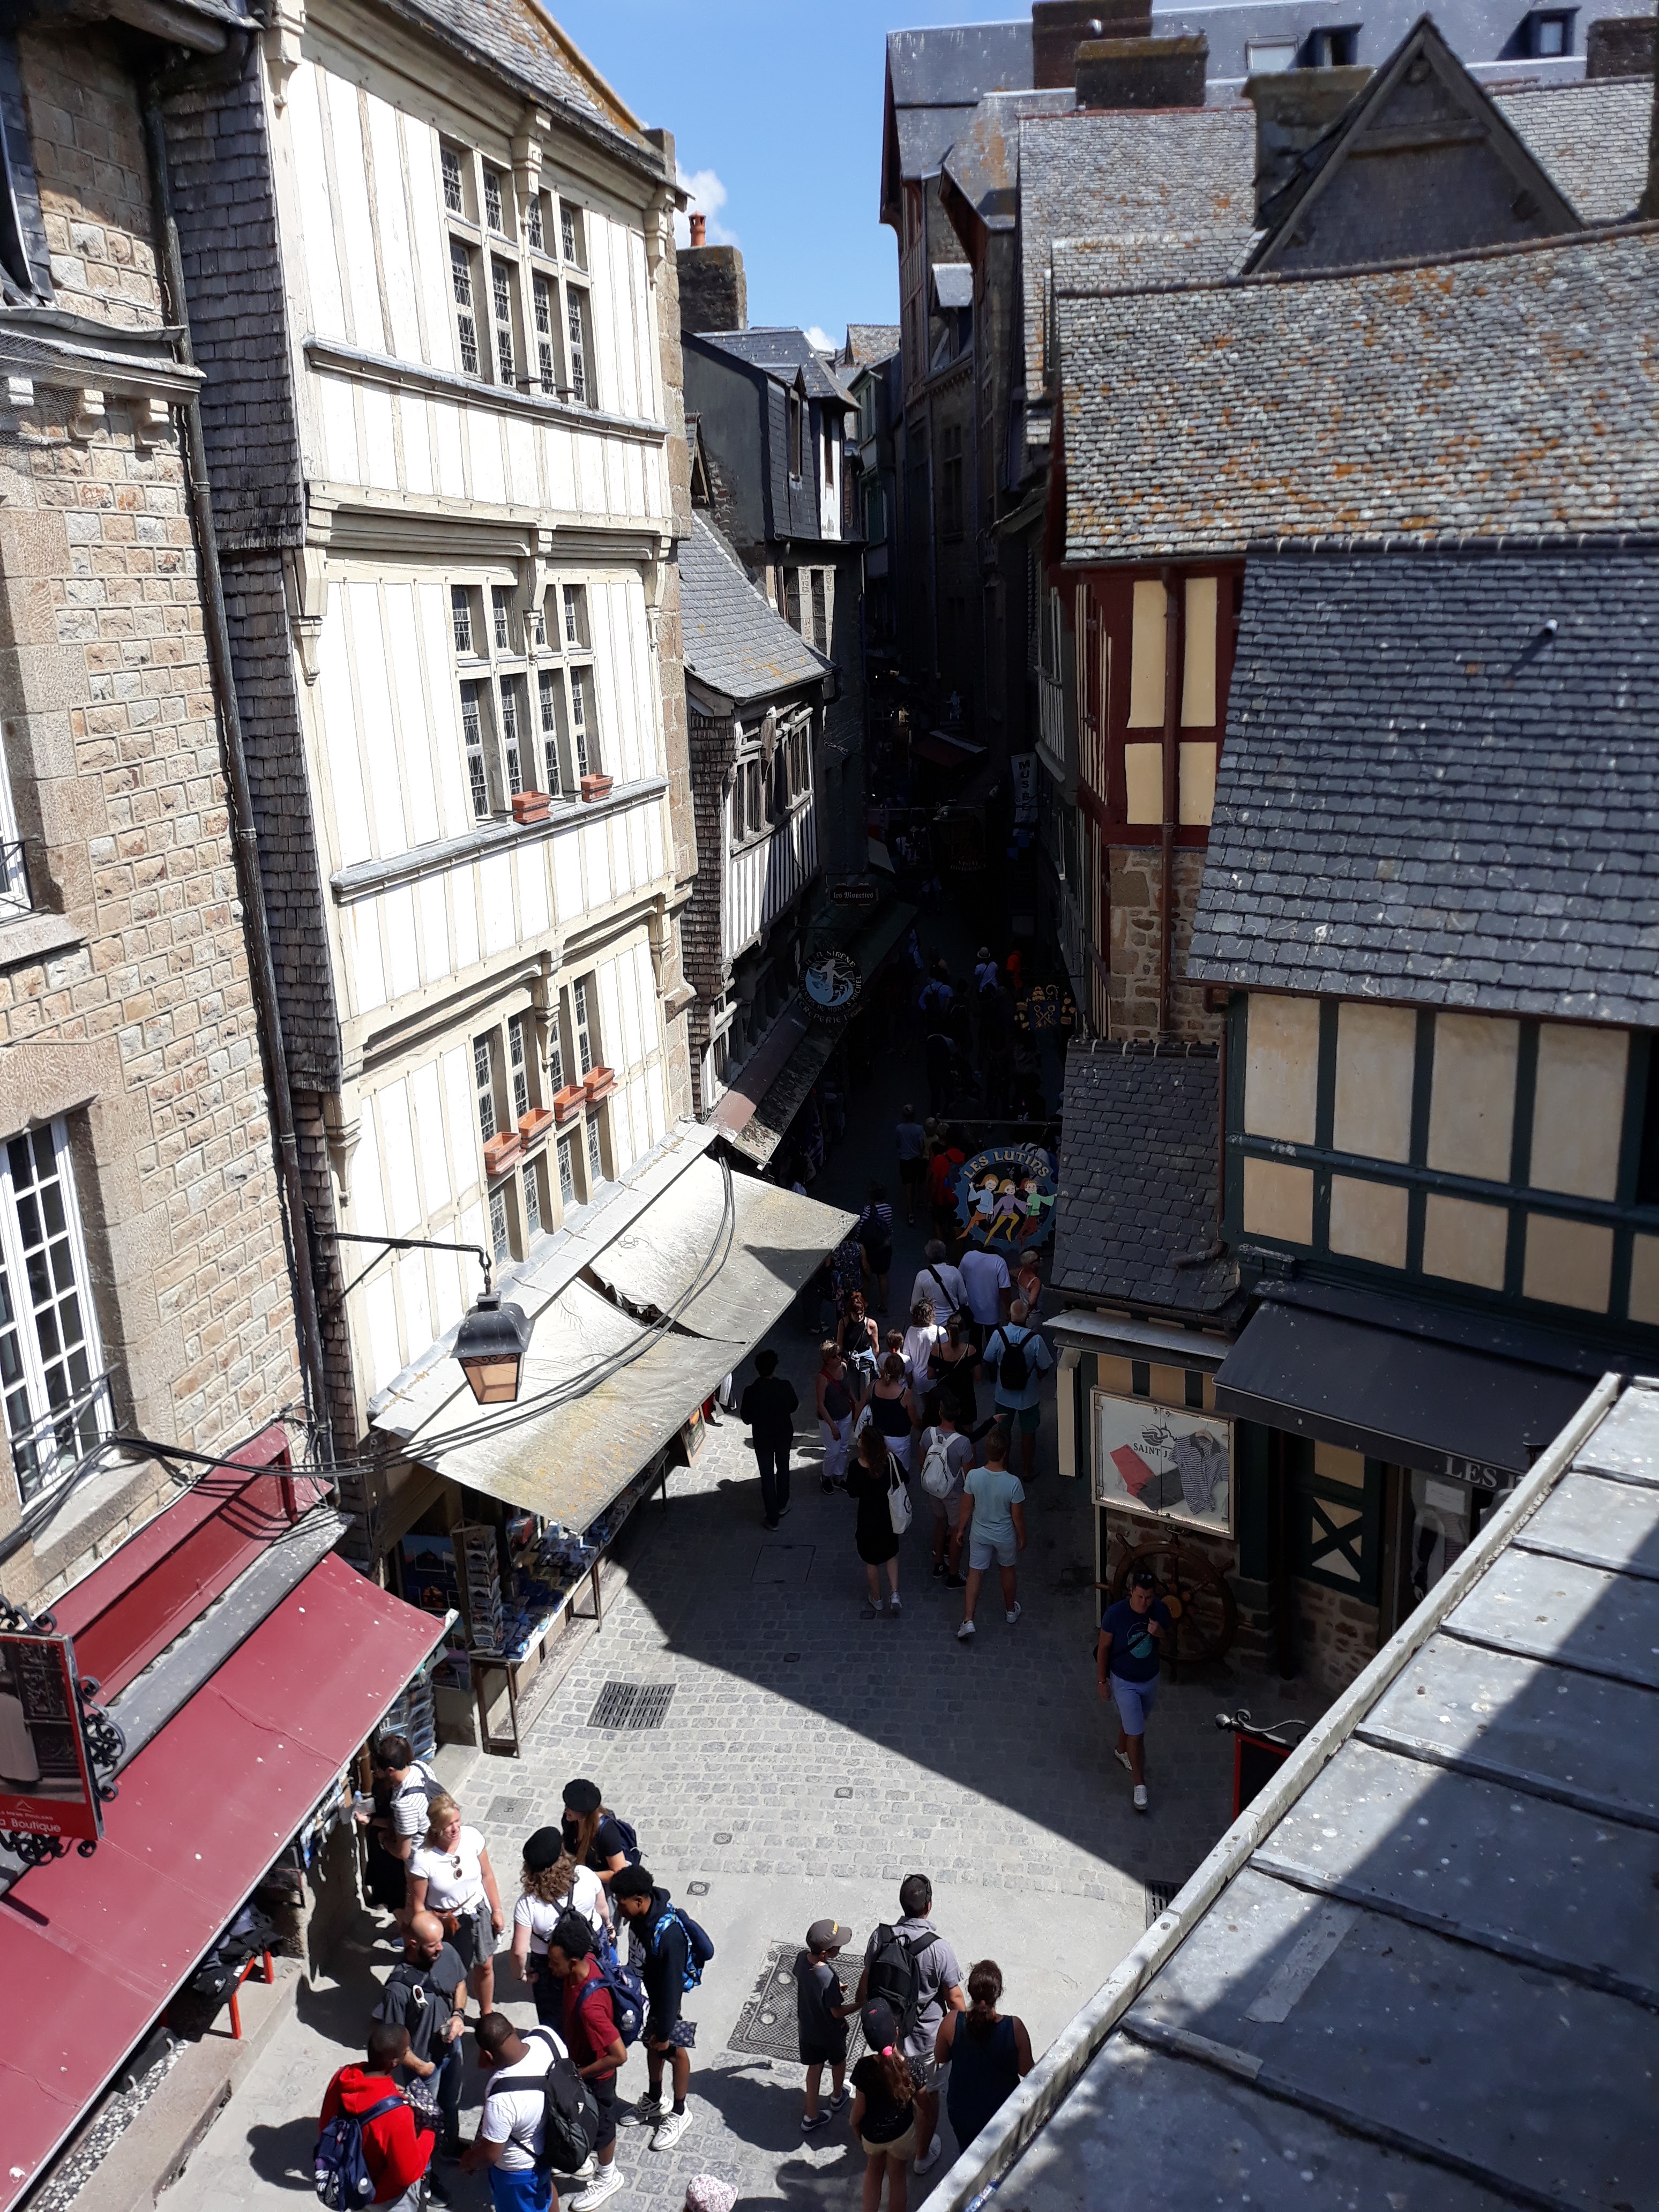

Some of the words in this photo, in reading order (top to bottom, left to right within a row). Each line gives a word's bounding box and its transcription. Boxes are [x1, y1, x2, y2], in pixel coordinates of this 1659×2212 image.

[851, 975, 862, 1001] MICHEL
[963, 1155, 989, 1179] LES
[993, 1150, 1049, 1177] LUTINS
[1133, 1443, 1161, 1456] SAINT
[1444, 1455, 1497, 1488] LES
[11, 1818, 61, 1833] Boutique
